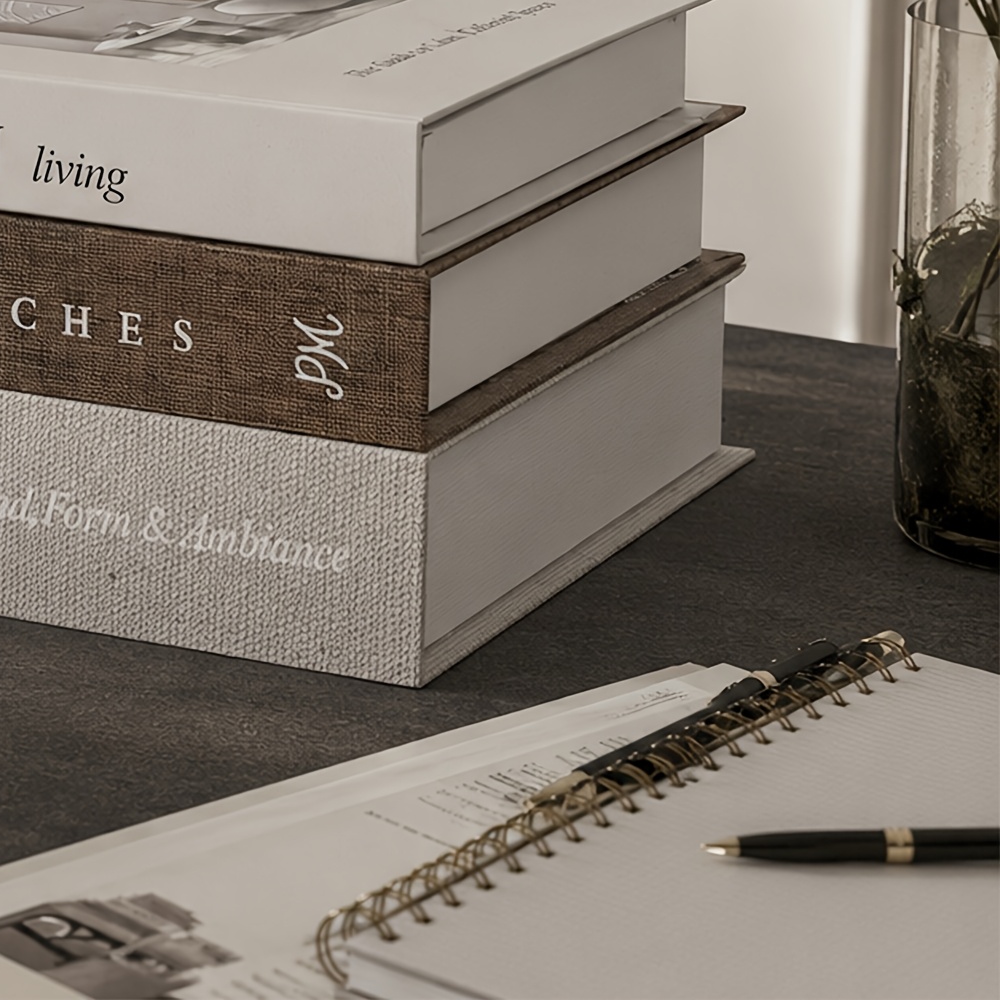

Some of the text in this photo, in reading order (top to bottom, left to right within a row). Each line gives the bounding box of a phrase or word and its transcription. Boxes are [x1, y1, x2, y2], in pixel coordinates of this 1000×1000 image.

[31, 145, 129, 204] living
[141, 505, 180, 545] &
[180, 512, 350, 573] Ambiance
